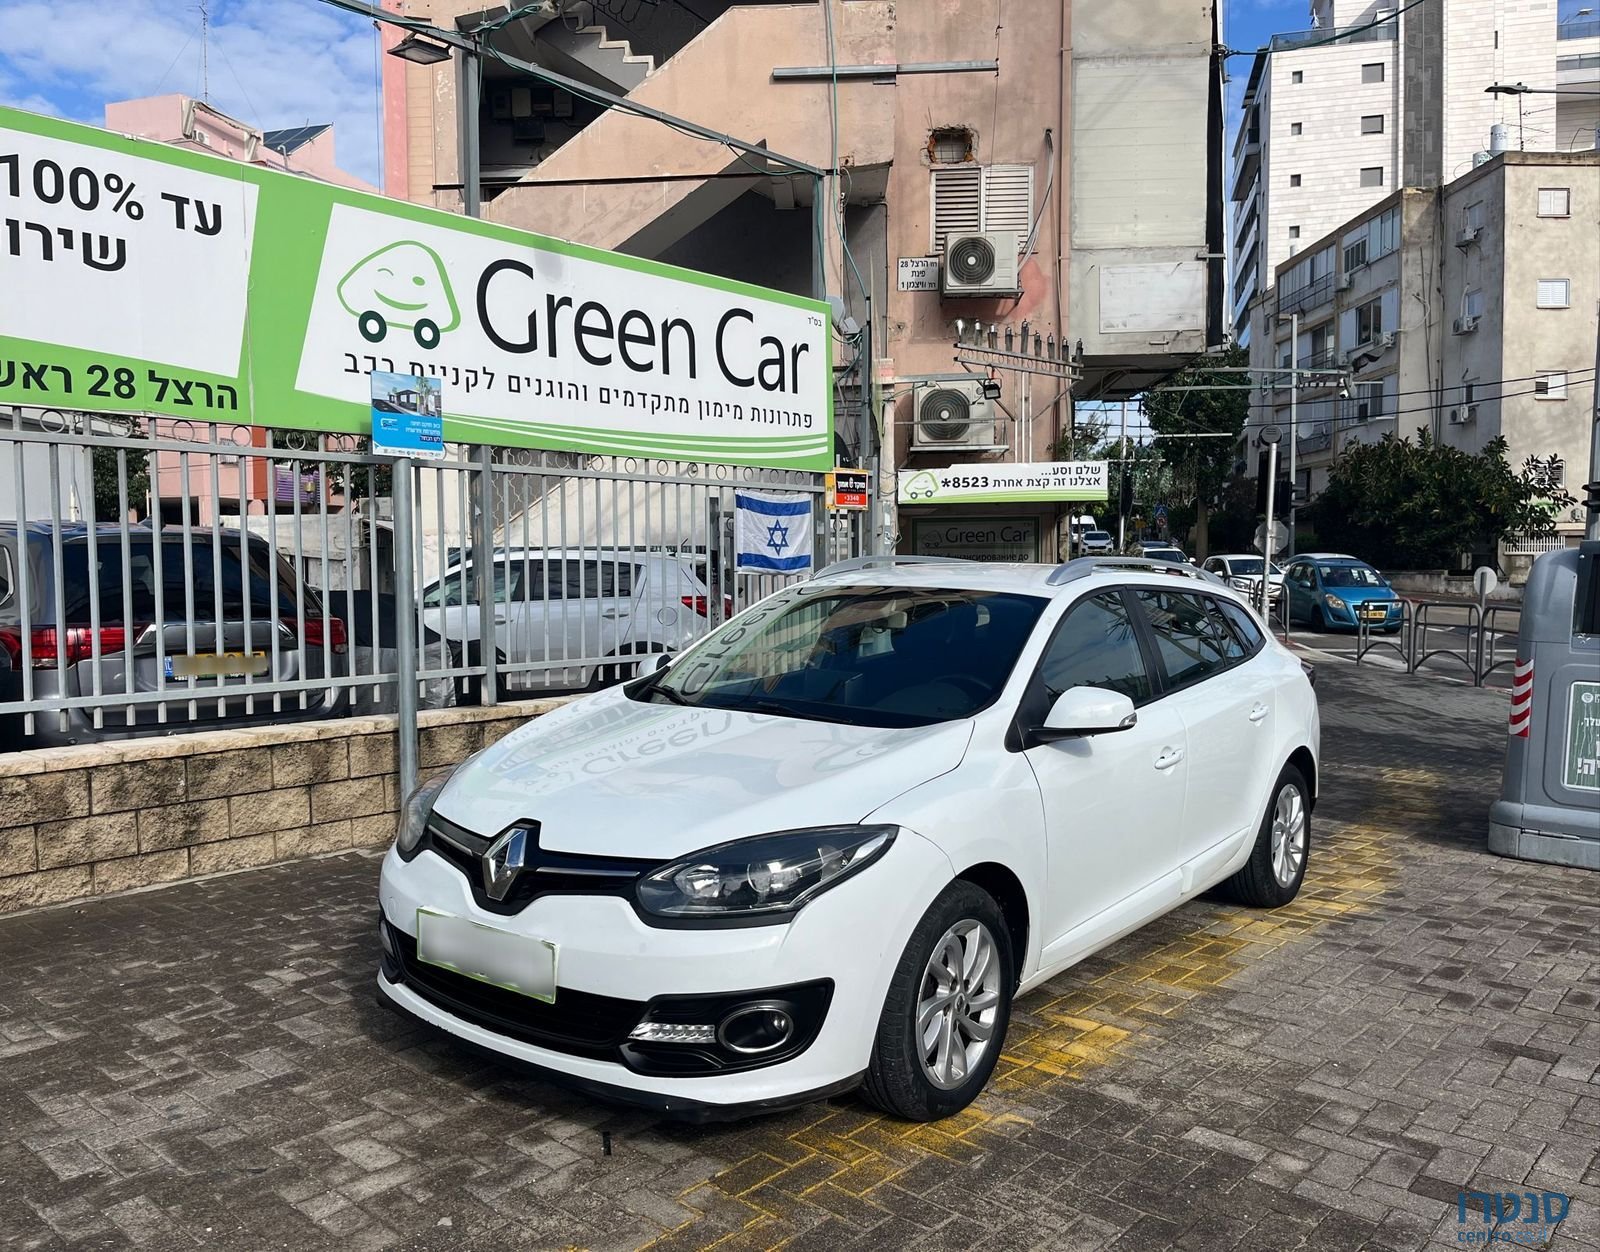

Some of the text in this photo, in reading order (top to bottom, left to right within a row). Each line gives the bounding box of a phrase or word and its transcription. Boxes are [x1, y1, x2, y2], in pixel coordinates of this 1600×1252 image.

[0, 153, 223, 236] עד 100%
[5, 218, 127, 272] שירו
[900, 260, 909, 268] 28
[910, 259, 929, 267] הרצל
[476, 258, 810, 395] Green Car
[807, 316, 823, 327] בס"ד
[87, 364, 136, 400] 28
[148, 370, 238, 411] הרצל
[344, 352, 813, 428] פתרונות מימון מתקדמים והוגנים לקניית רכב
[1075, 464, 1101, 475] שלם
[992, 478, 1023, 488] אחרת
[1026, 478, 1050, 489] קצת
[1053, 477, 1066, 486] זה
[1069, 476, 1101, 486] אצלנו
[945, 526, 1030, 543] Green Car
[1018, 553, 1029, 562] до
